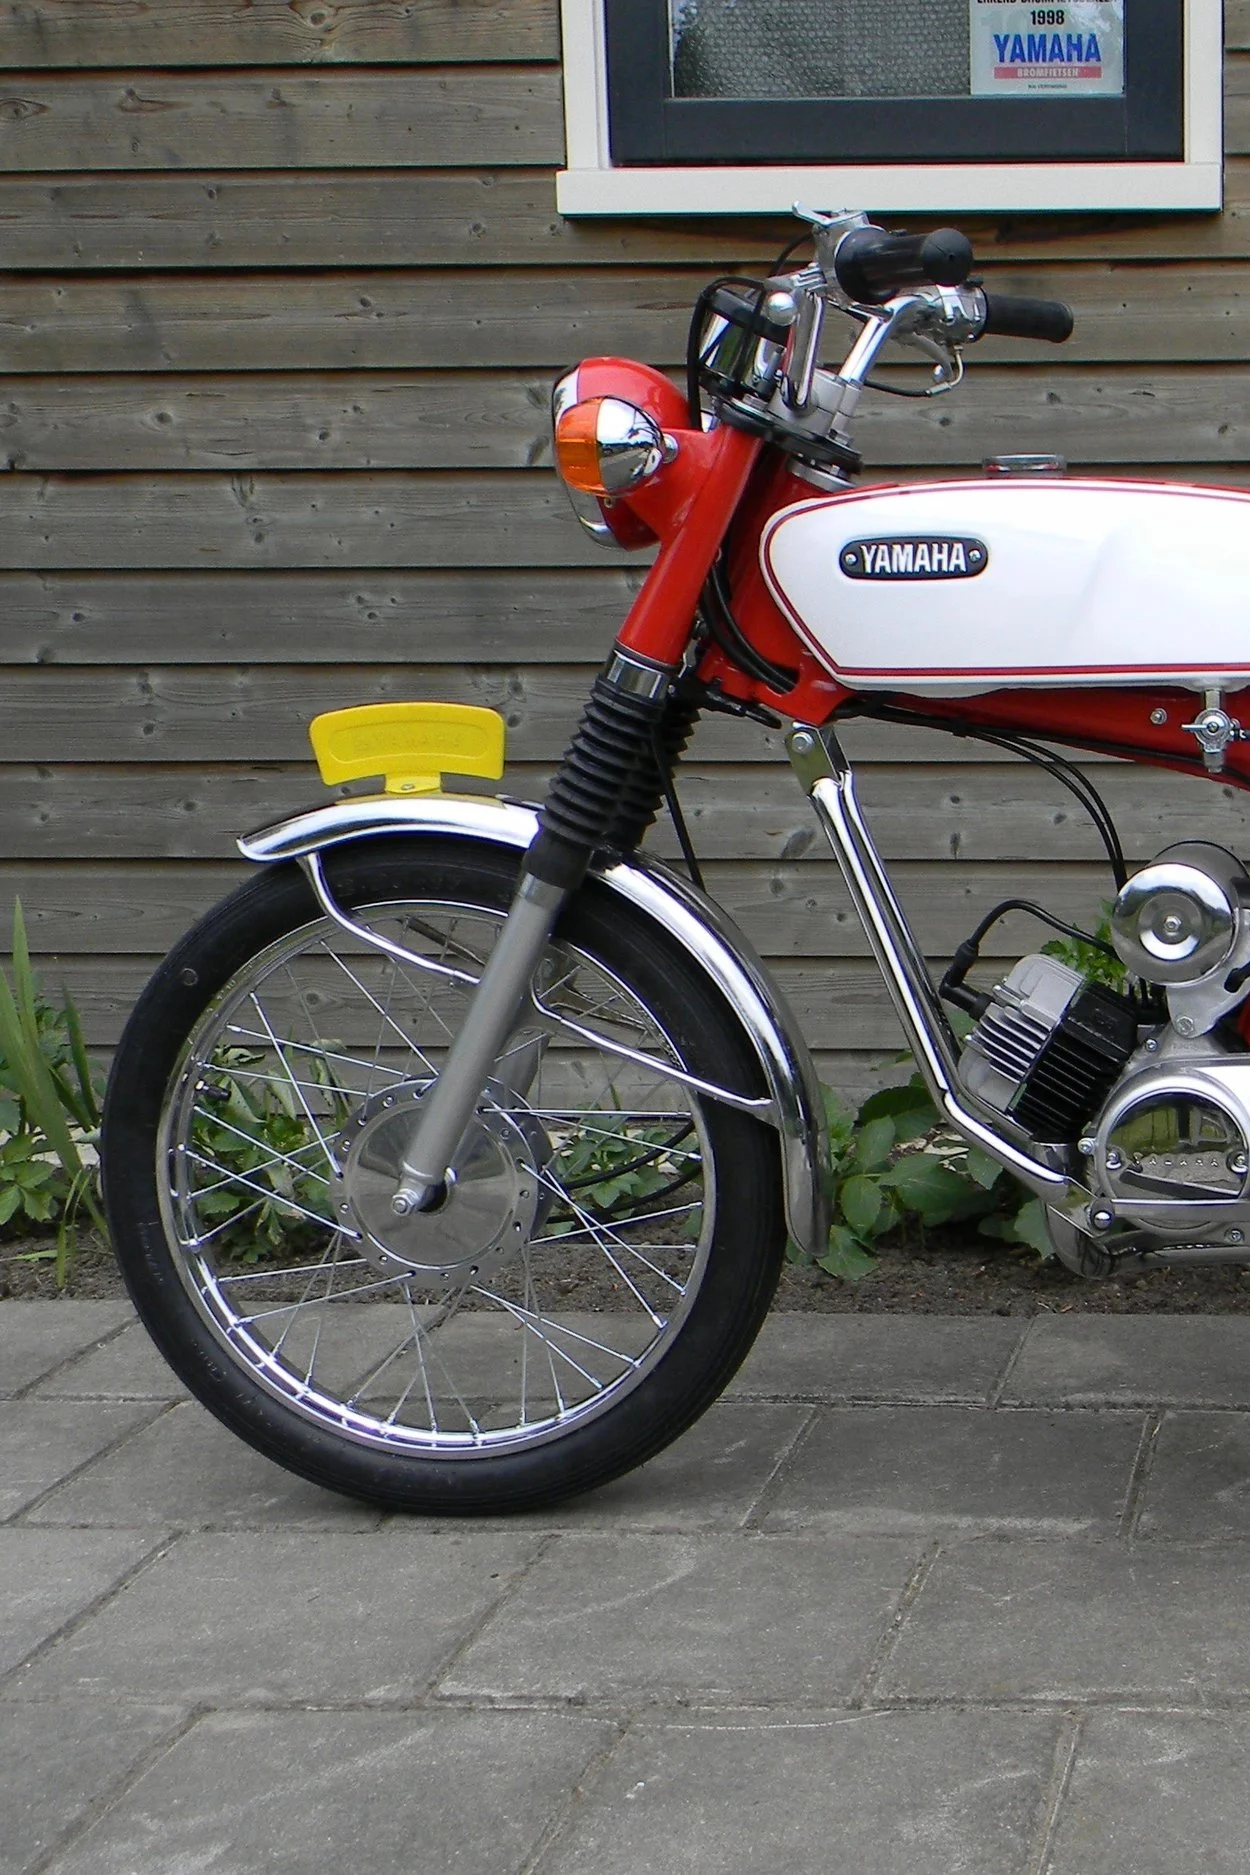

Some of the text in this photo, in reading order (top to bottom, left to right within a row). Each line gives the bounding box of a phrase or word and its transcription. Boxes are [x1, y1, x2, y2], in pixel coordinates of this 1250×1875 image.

[1030, 9, 1065, 26] 1998
[993, 33, 1102, 63] YAMAHA
[1016, 67, 1080, 78] BROMFIETSEN
[860, 541, 967, 574] YAMAHA
